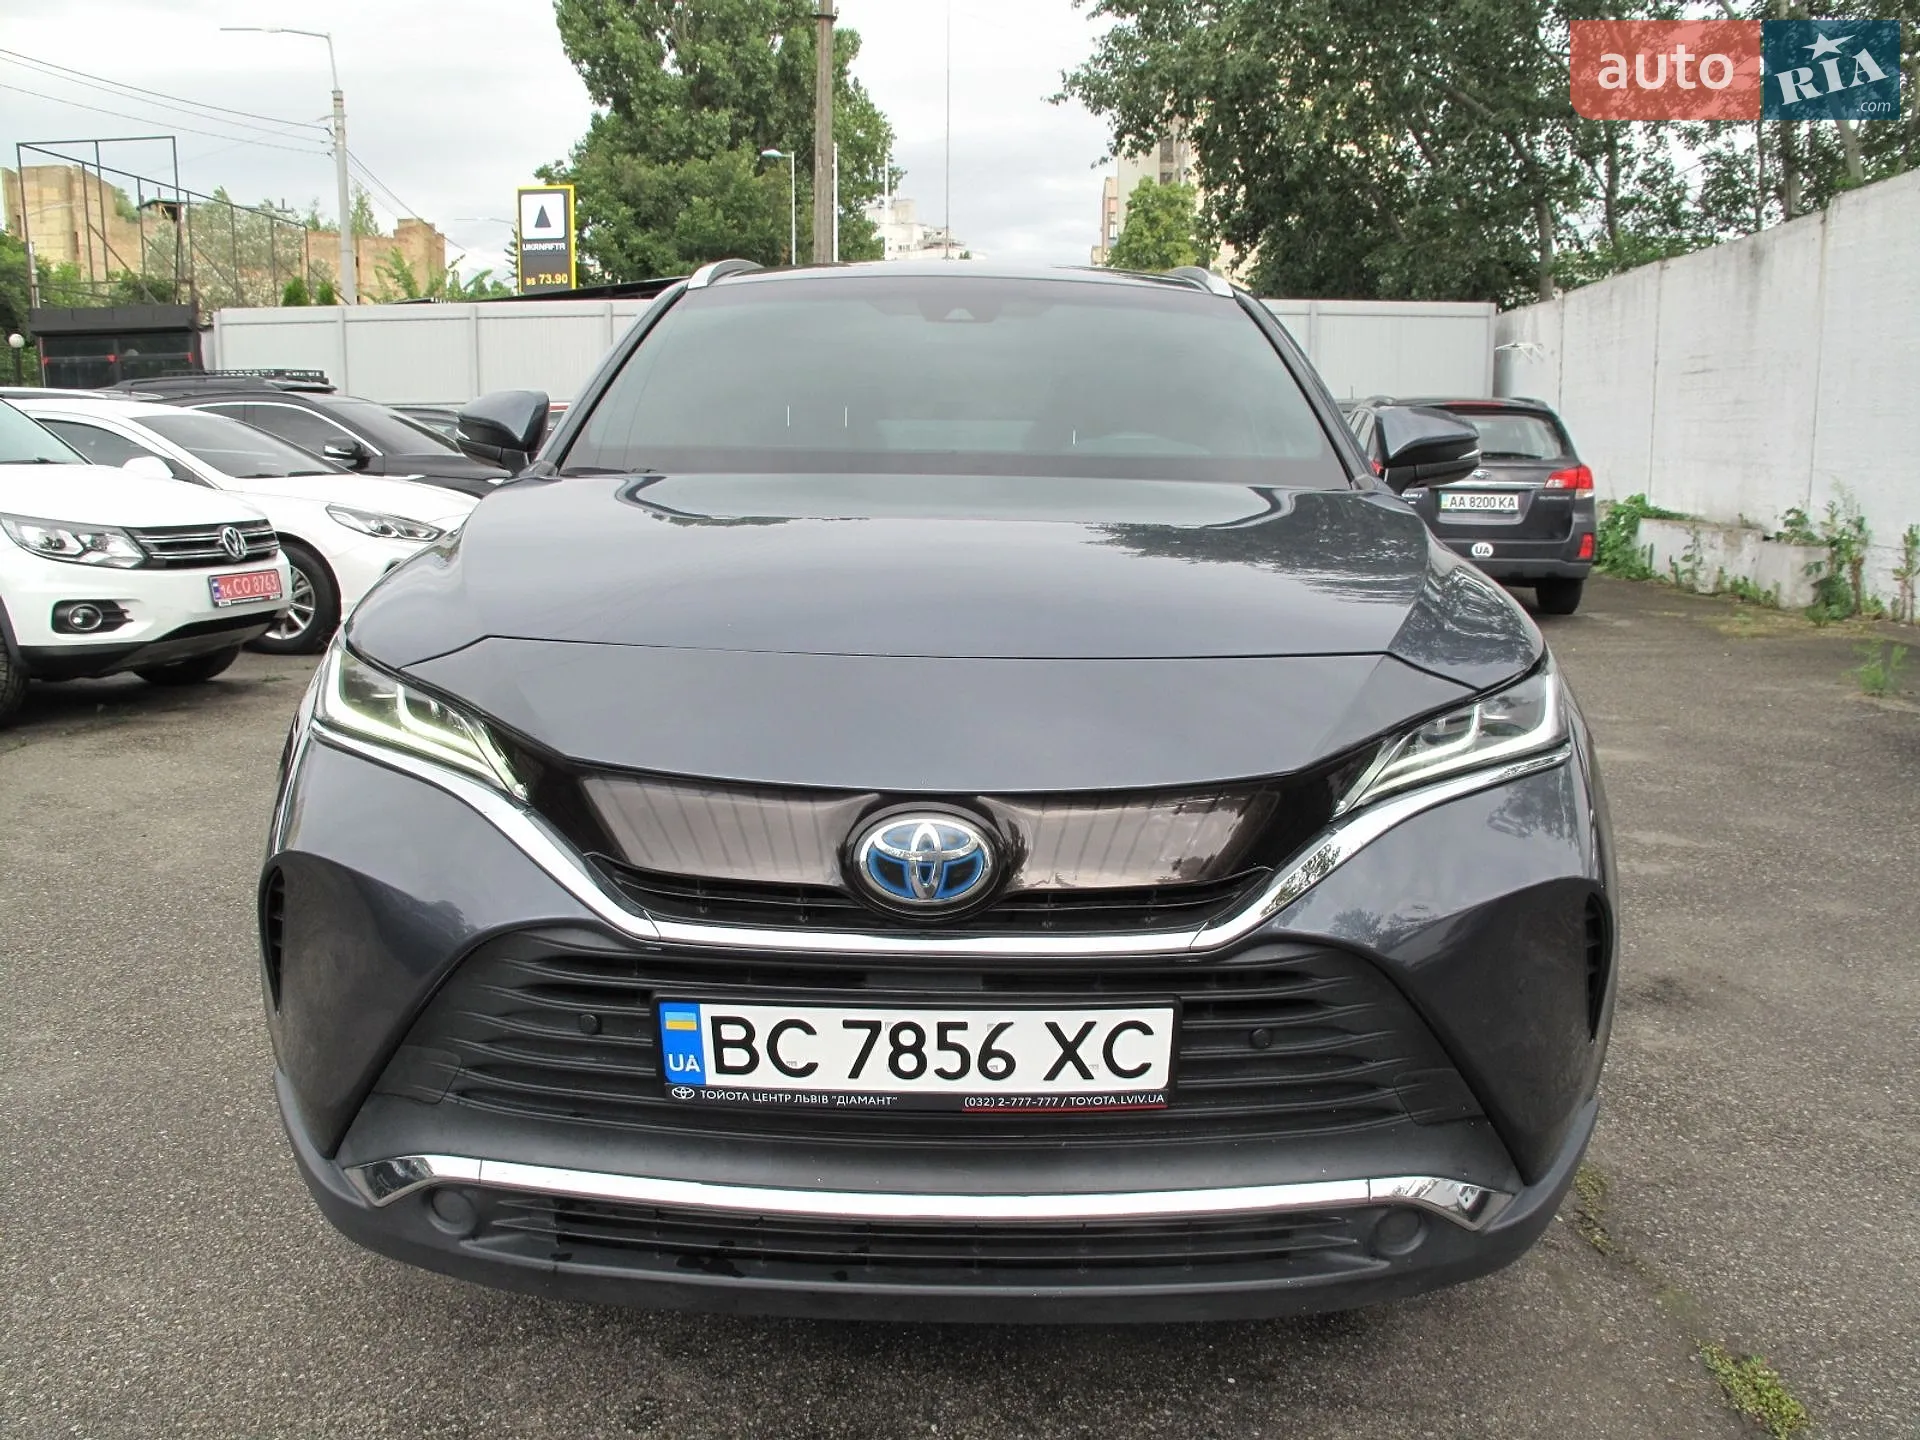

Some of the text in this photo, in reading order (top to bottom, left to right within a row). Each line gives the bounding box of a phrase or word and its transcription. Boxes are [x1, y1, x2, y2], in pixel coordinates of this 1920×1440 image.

[539, 273, 569, 284] 73.90
[1450, 496, 1516, 508] AA 8200 KA
[1474, 545, 1490, 555] UA
[253, 573, 277, 593] 8763
[710, 1015, 1155, 1081] BC 7856 XC
[668, 1053, 701, 1072] UA
[700, 1088, 749, 1101] ТОЙОТА
[752, 1091, 791, 1104] ЦЕНТР
[793, 1094, 829, 1104] ЛЬВІВ
[964, 1096, 995, 1108] (032)
[998, 1096, 1059, 1107] 2-777-777
[1069, 1094, 1165, 1106] TOYOTA.LVIV.UA
